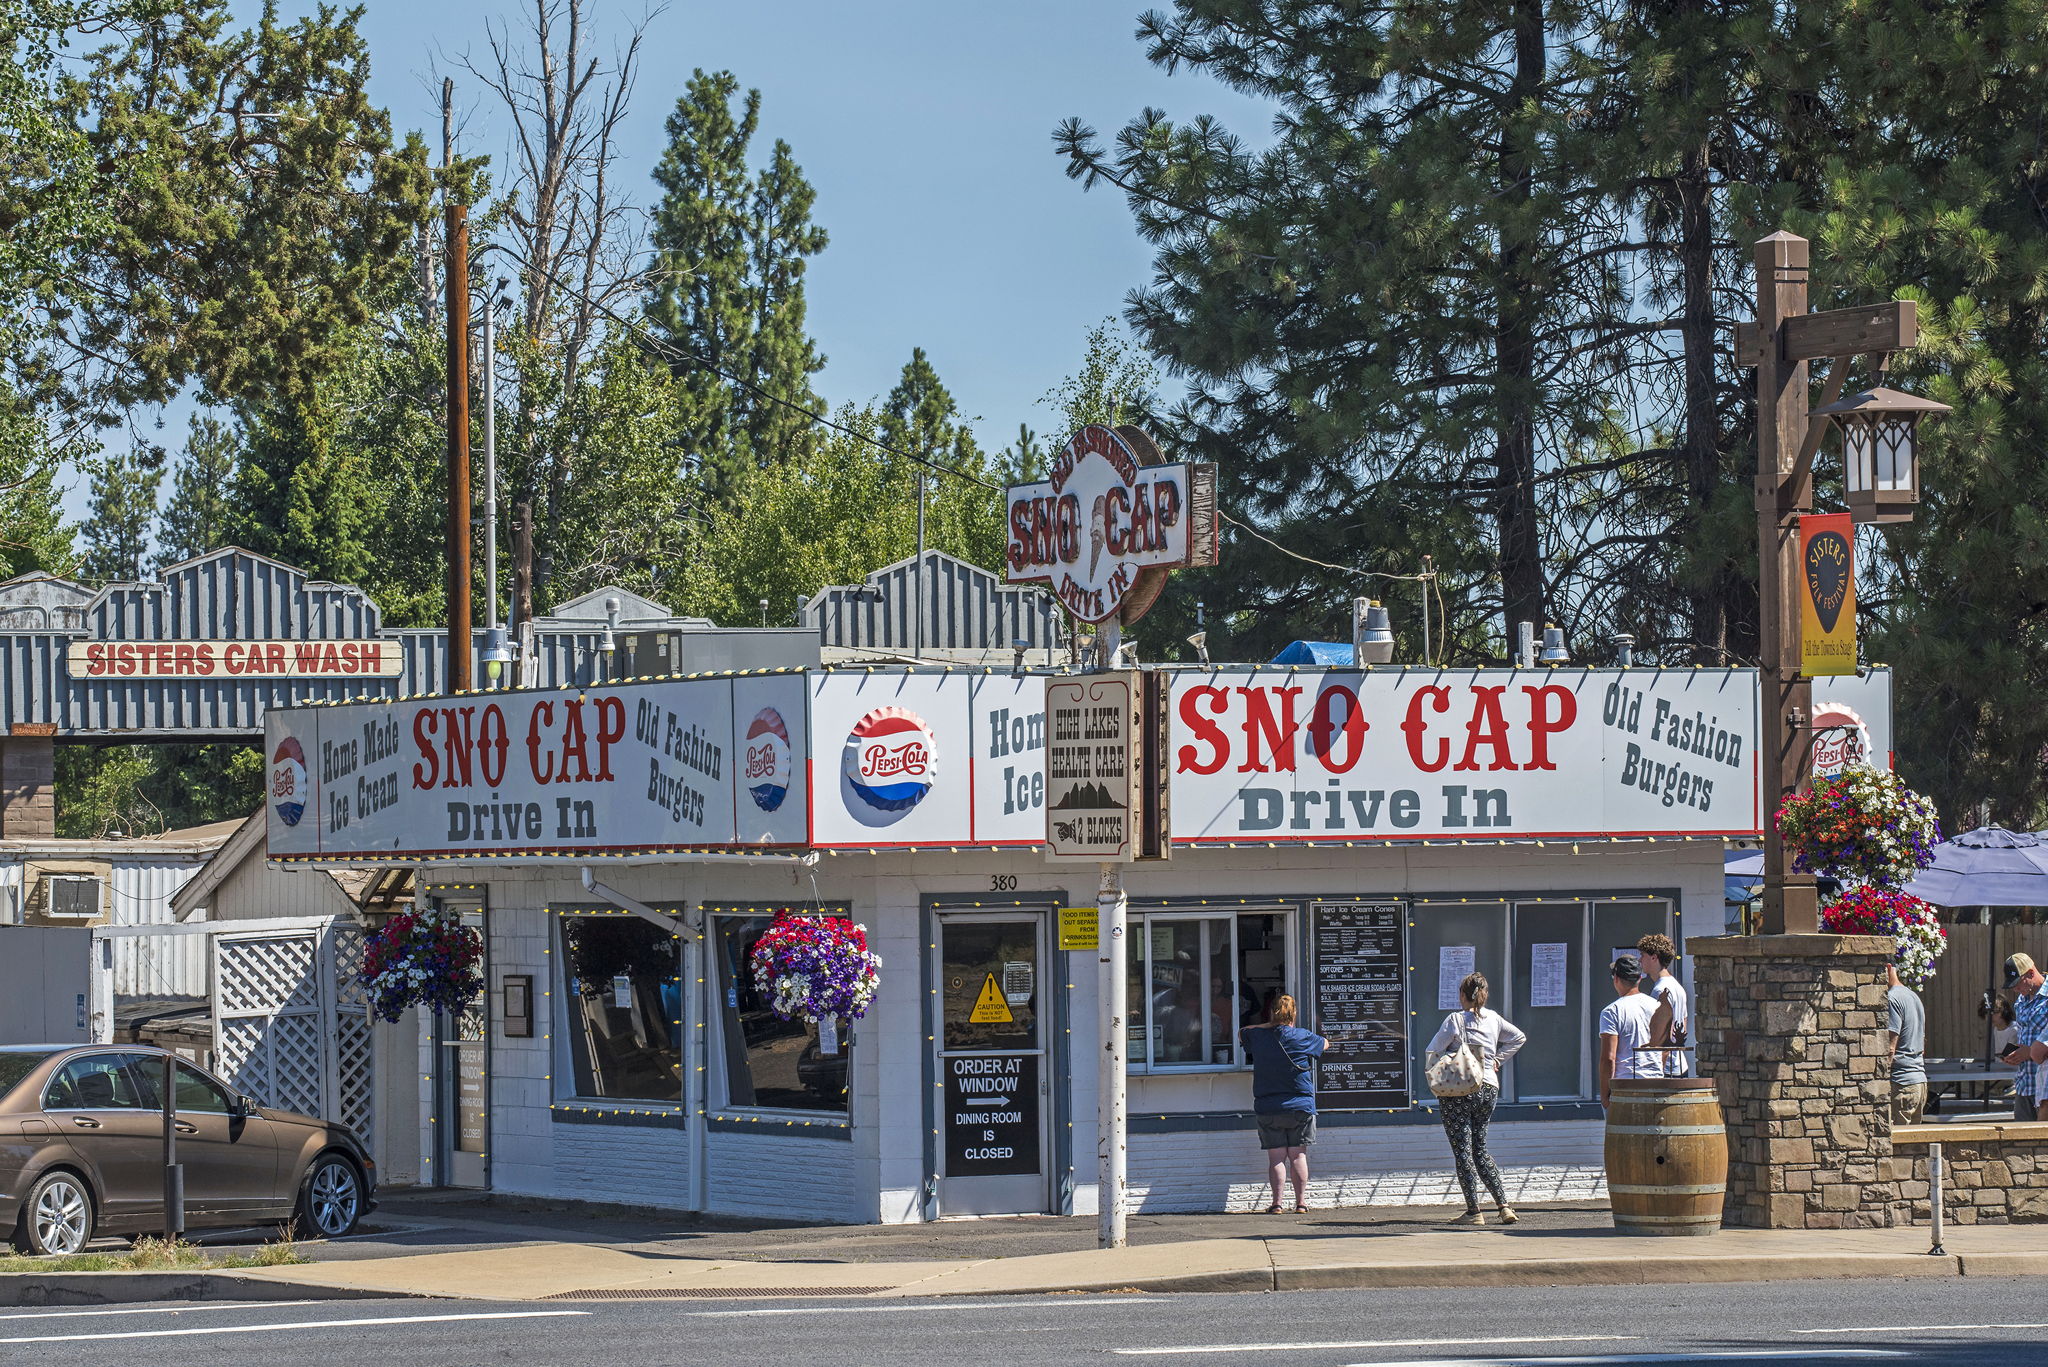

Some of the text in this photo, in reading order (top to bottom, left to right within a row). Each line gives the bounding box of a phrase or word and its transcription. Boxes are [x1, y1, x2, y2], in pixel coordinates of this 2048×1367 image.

[1051, 449, 1073, 494] OLD
[1008, 480, 1179, 573] SNO CAP
[1810, 537, 1846, 568] SISTERS
[1059, 562, 1129, 617] DRIVE IN
[1823, 571, 1846, 610] FESTIVAL
[86, 643, 381, 675] SISTERS CAR WASH
[412, 696, 626, 790] SNO CAP
[636, 697, 721, 781] Old Fashion
[989, 707, 1045, 759] Hom
[1056, 707, 1119, 741] HIGH LAKES
[1176, 684, 1577, 775] SNO CAP
[1603, 682, 1742, 769] Old Fashion
[323, 713, 399, 785] Home Made
[1052, 746, 1124, 778] HEALTH CARE
[647, 757, 705, 828] Burgers
[1003, 766, 1044, 816] Ice
[1620, 742, 1714, 812] Burgers
[330, 772, 398, 834] Ice Cream
[447, 792, 597, 842] Drive In
[1238, 778, 1512, 831] Drive In
[1077, 816, 1122, 844] 2 BLOCKS
[989, 874, 1018, 891] 380
[1152, 965, 1181, 984] OPEN
[954, 1058, 1022, 1075] ORDER AT
[959, 1077, 1018, 1093] WINDOW
[1322, 1064, 1353, 1072] DRINKS
[956, 1112, 1022, 1125] DINING ROOM
[983, 1130, 995, 1141] IS
[965, 1147, 1014, 1159] CLOSED
